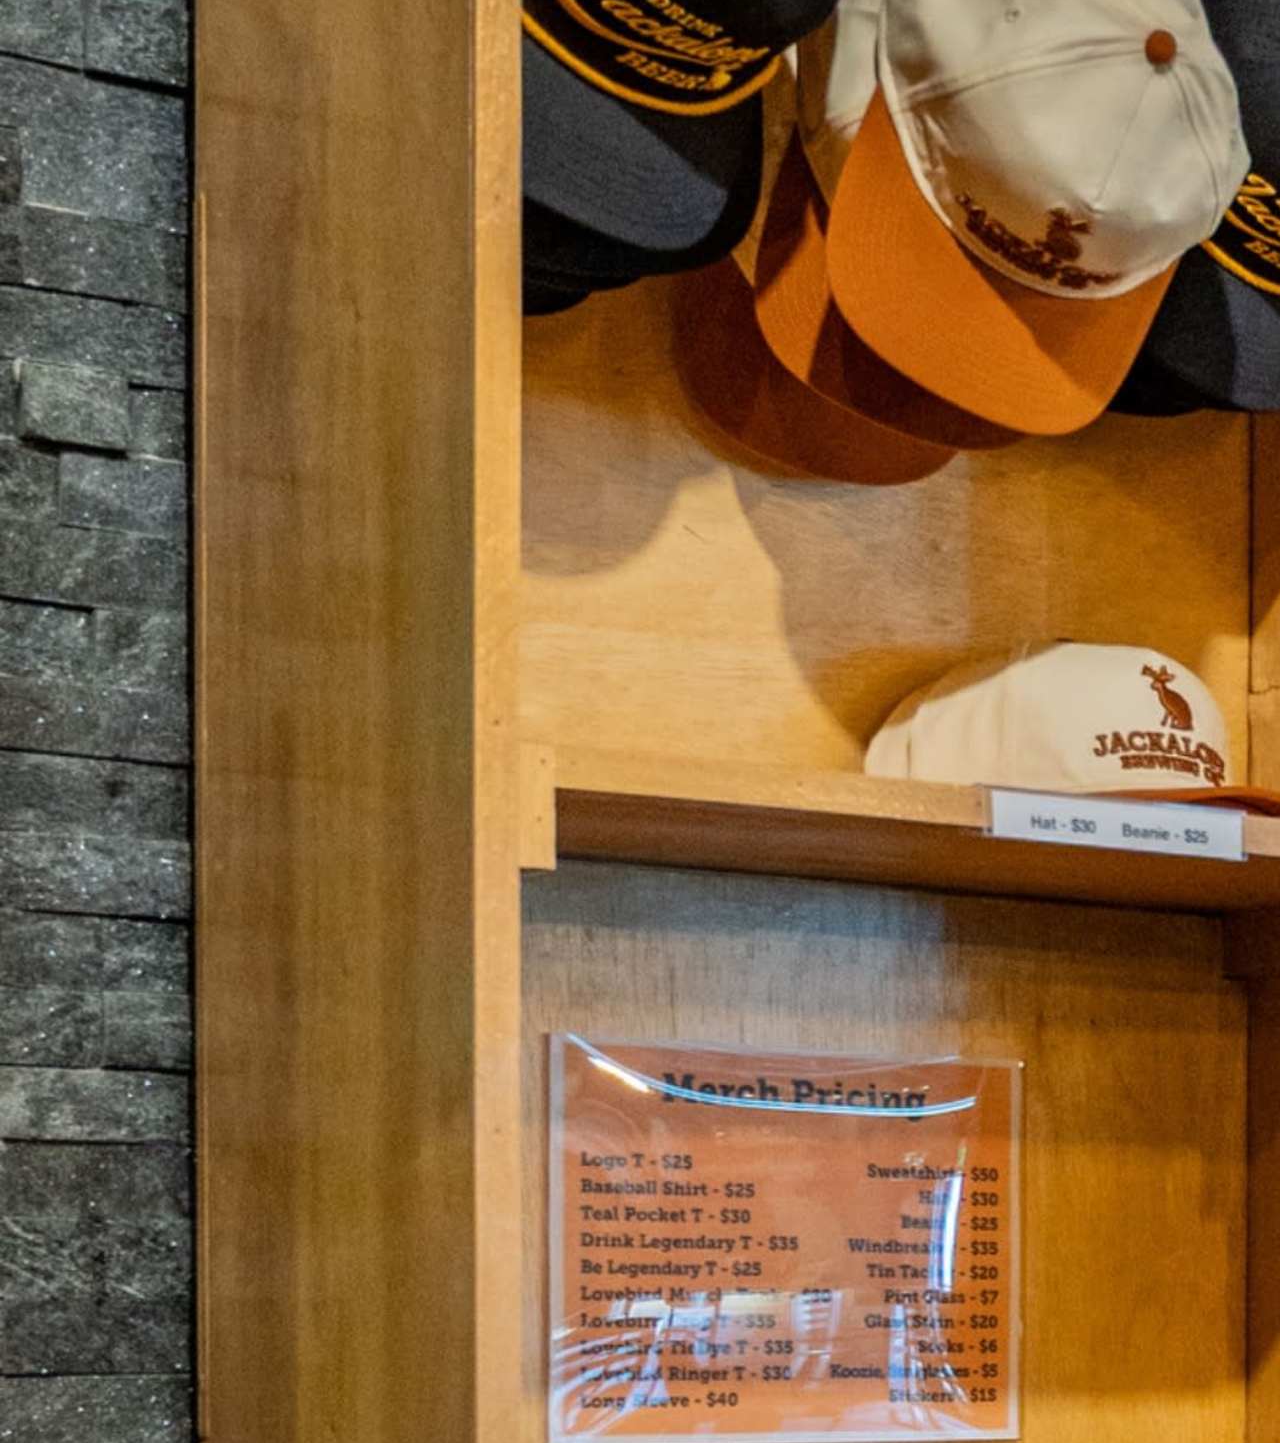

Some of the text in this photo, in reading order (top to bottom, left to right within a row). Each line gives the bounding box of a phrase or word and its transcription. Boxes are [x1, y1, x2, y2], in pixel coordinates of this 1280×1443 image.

[1030, 815, 1209, 844] Hat $30 Beanie $25
[791, 1078, 927, 1121] Pricing
[581, 1152, 693, 1170] Logo T $25
[970, 1167, 998, 1182] $50
[581, 1179, 755, 1198] Baseball Shirt $25
[970, 1192, 998, 1207] $30
[581, 1205, 751, 1224] Teal Pocket T $30
[970, 1217, 998, 1232] $25
[581, 1232, 799, 1252] Drink Legendary T $35
[970, 1241, 998, 1256] $35
[581, 1259, 762, 1278] Be Legendary T $25
[867, 1263, 895, 1279] Tin
[969, 1265, 998, 1281] $20
[884, 1289, 919, 1304] Pint
[980, 1290, 999, 1305] $7
[969, 1314, 998, 1330] $20
[736, 1342, 748, 1356] T
[764, 1340, 794, 1356] $35
[979, 1339, 998, 1354] $6
[668, 1366, 730, 1385] Ringer
[734, 1367, 747, 1382] T
[981, 1363, 998, 1378] $5
[706, 1392, 739, 1407] $40
[969, 1388, 998, 1403] $15
